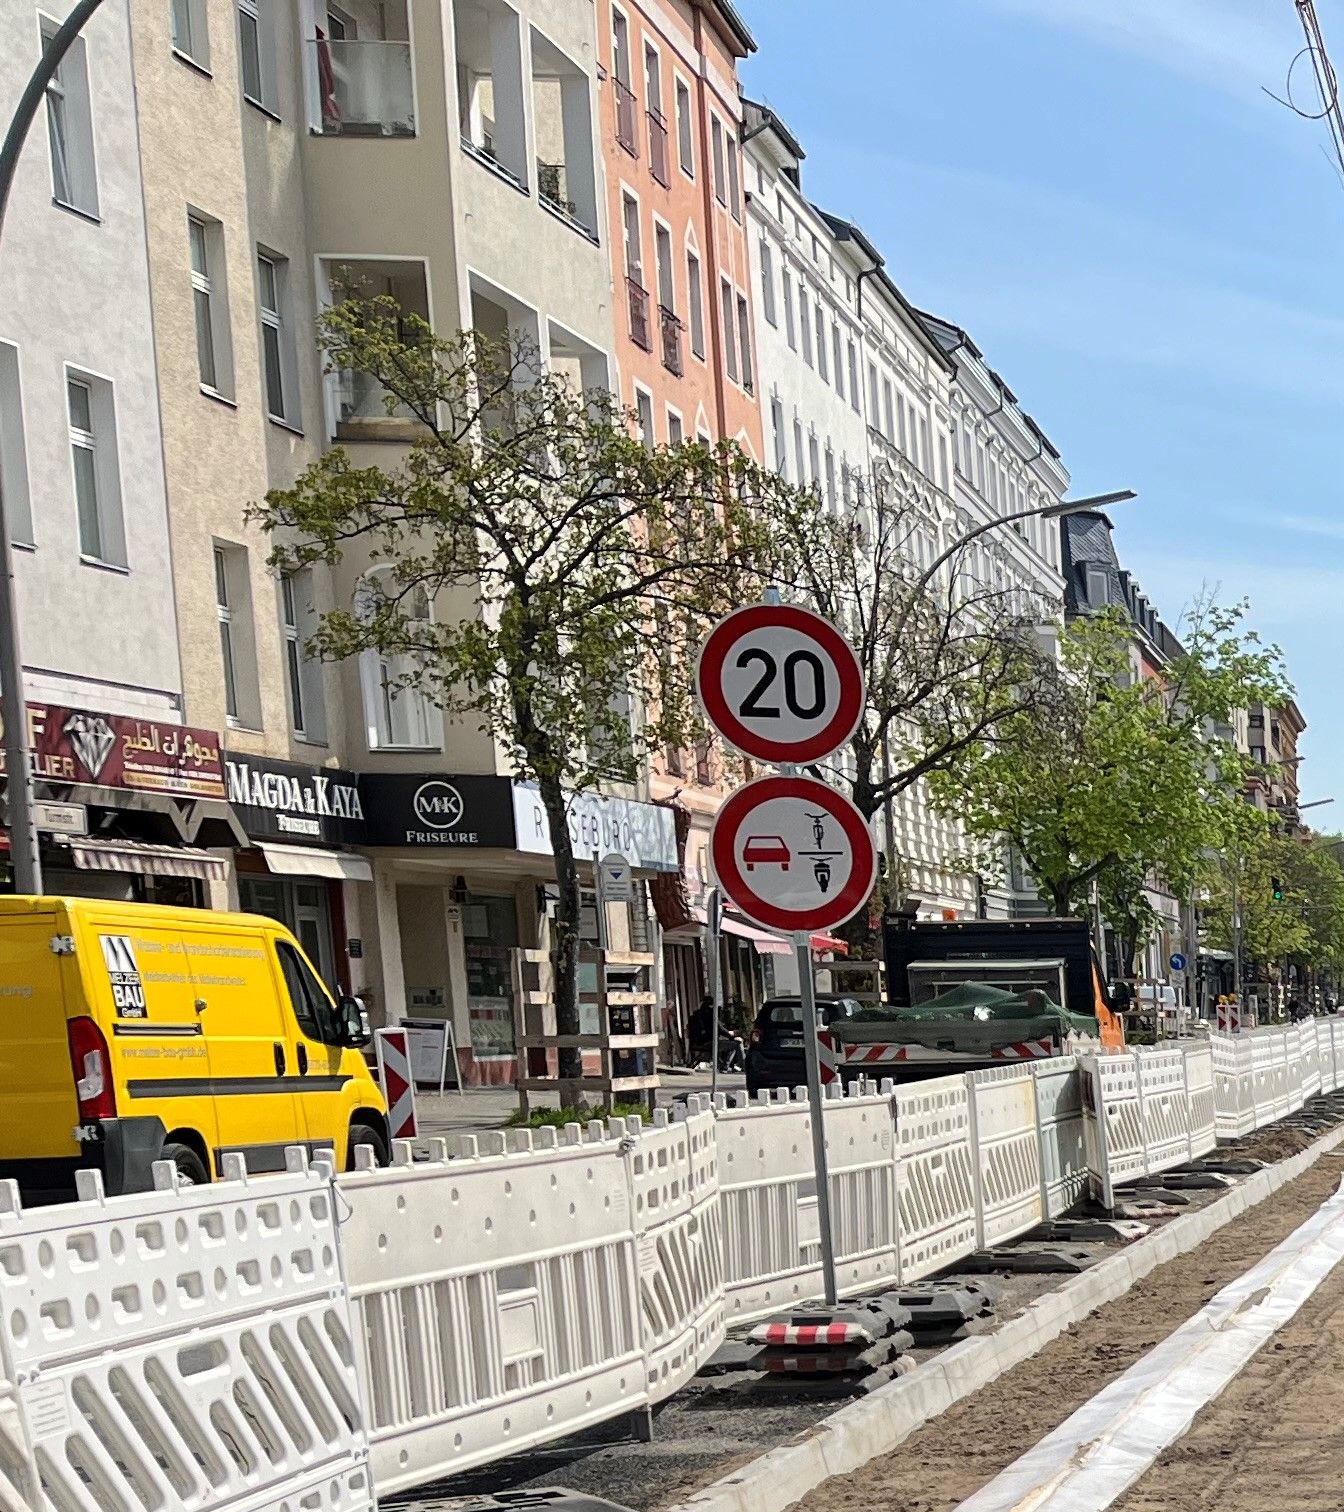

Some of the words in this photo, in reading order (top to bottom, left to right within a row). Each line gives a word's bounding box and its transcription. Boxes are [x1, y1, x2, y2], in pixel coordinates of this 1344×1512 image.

[735, 647, 827, 720] 20
[406, 830, 479, 843] FRISEURE
[112, 985, 145, 1007] BAU
